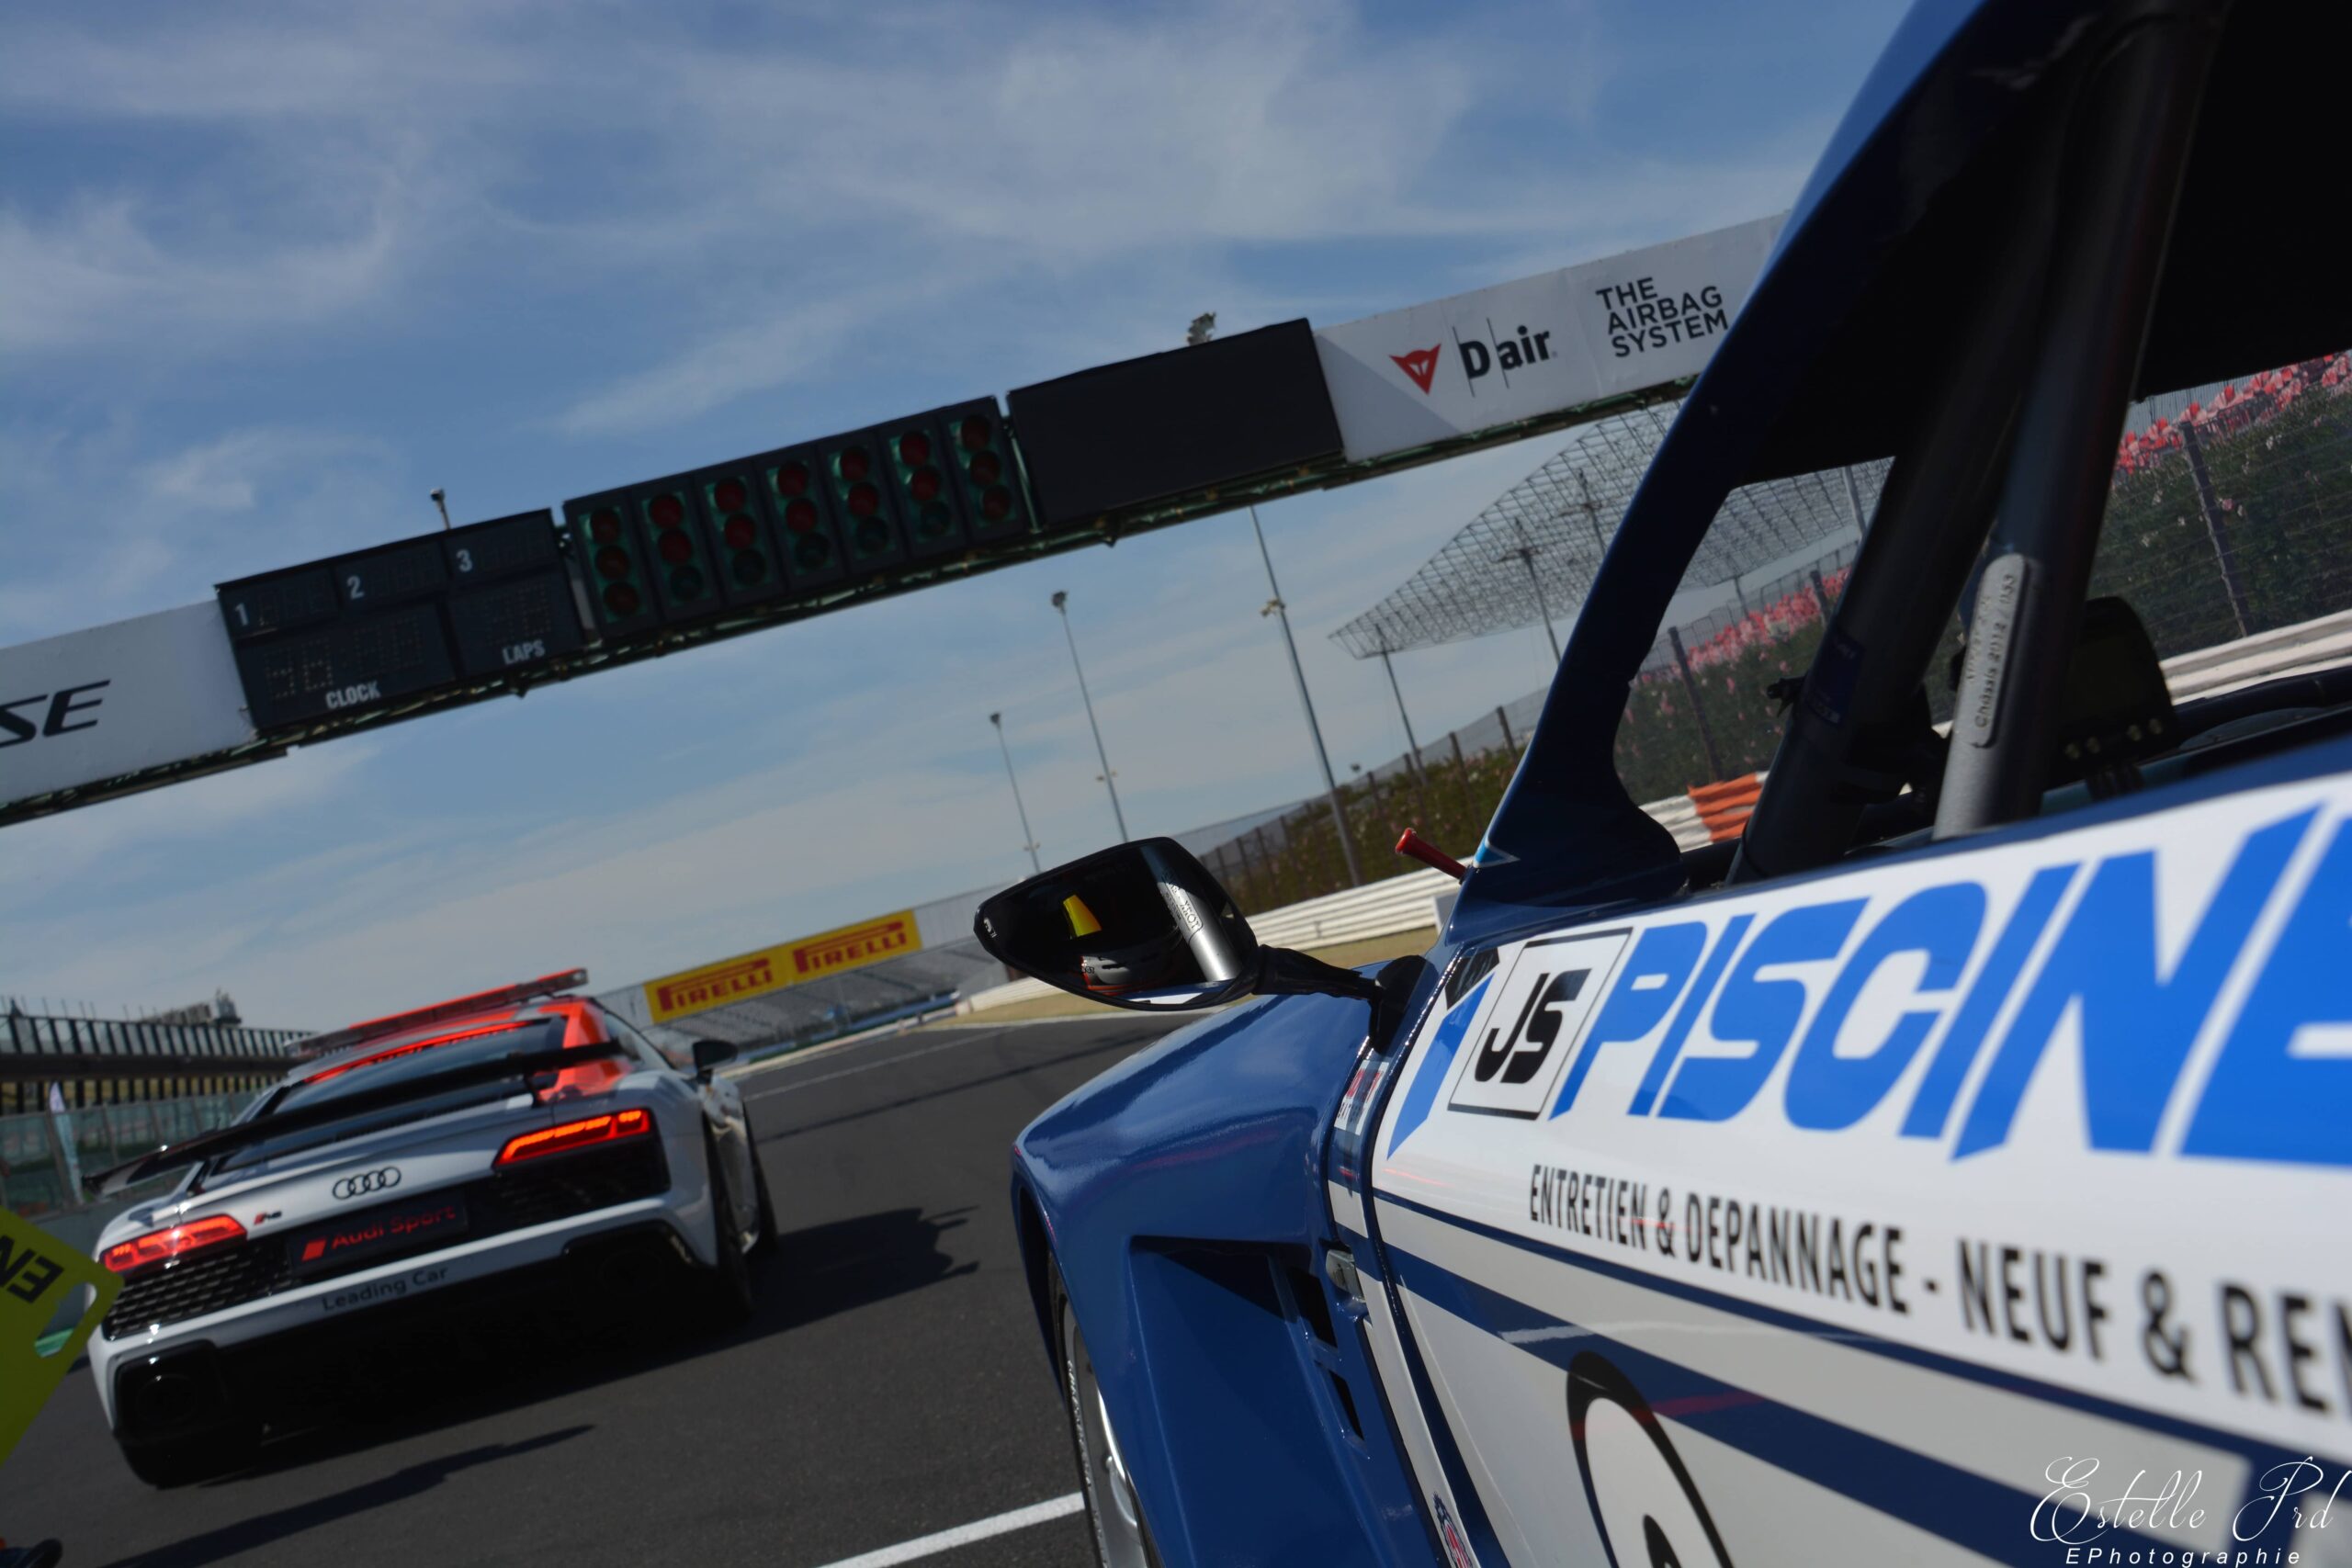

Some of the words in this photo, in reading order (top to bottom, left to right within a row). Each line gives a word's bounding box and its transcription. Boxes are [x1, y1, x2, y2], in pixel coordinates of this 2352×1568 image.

[1595, 276, 1657, 310] THE
[1609, 286, 1724, 335] AIRBAG
[1611, 309, 1729, 357] SYSTEM
[457, 548, 473, 572] 3
[346, 575, 364, 600] 2
[235, 602, 249, 626] 1
[502, 638, 546, 665] LAPS
[325, 680, 381, 710] CLOCK
[793, 920, 908, 974] PIRELLI
[656, 957, 774, 1011] PIRELLI
[1475, 967, 1593, 1084] JS
[332, 1222, 384, 1250] Audi
[390, 1206, 457, 1234] Sport
[322, 1277, 407, 1312] Leading
[413, 1267, 447, 1286] Car
[1530, 1164, 1648, 1250] ENTRETIEN
[1657, 1187, 1676, 1258] &
[1684, 1191, 1910, 1314] DEPANNAGE
[1956, 1237, 2107, 1360] NEUF
[2141, 1269, 2199, 1385] &
